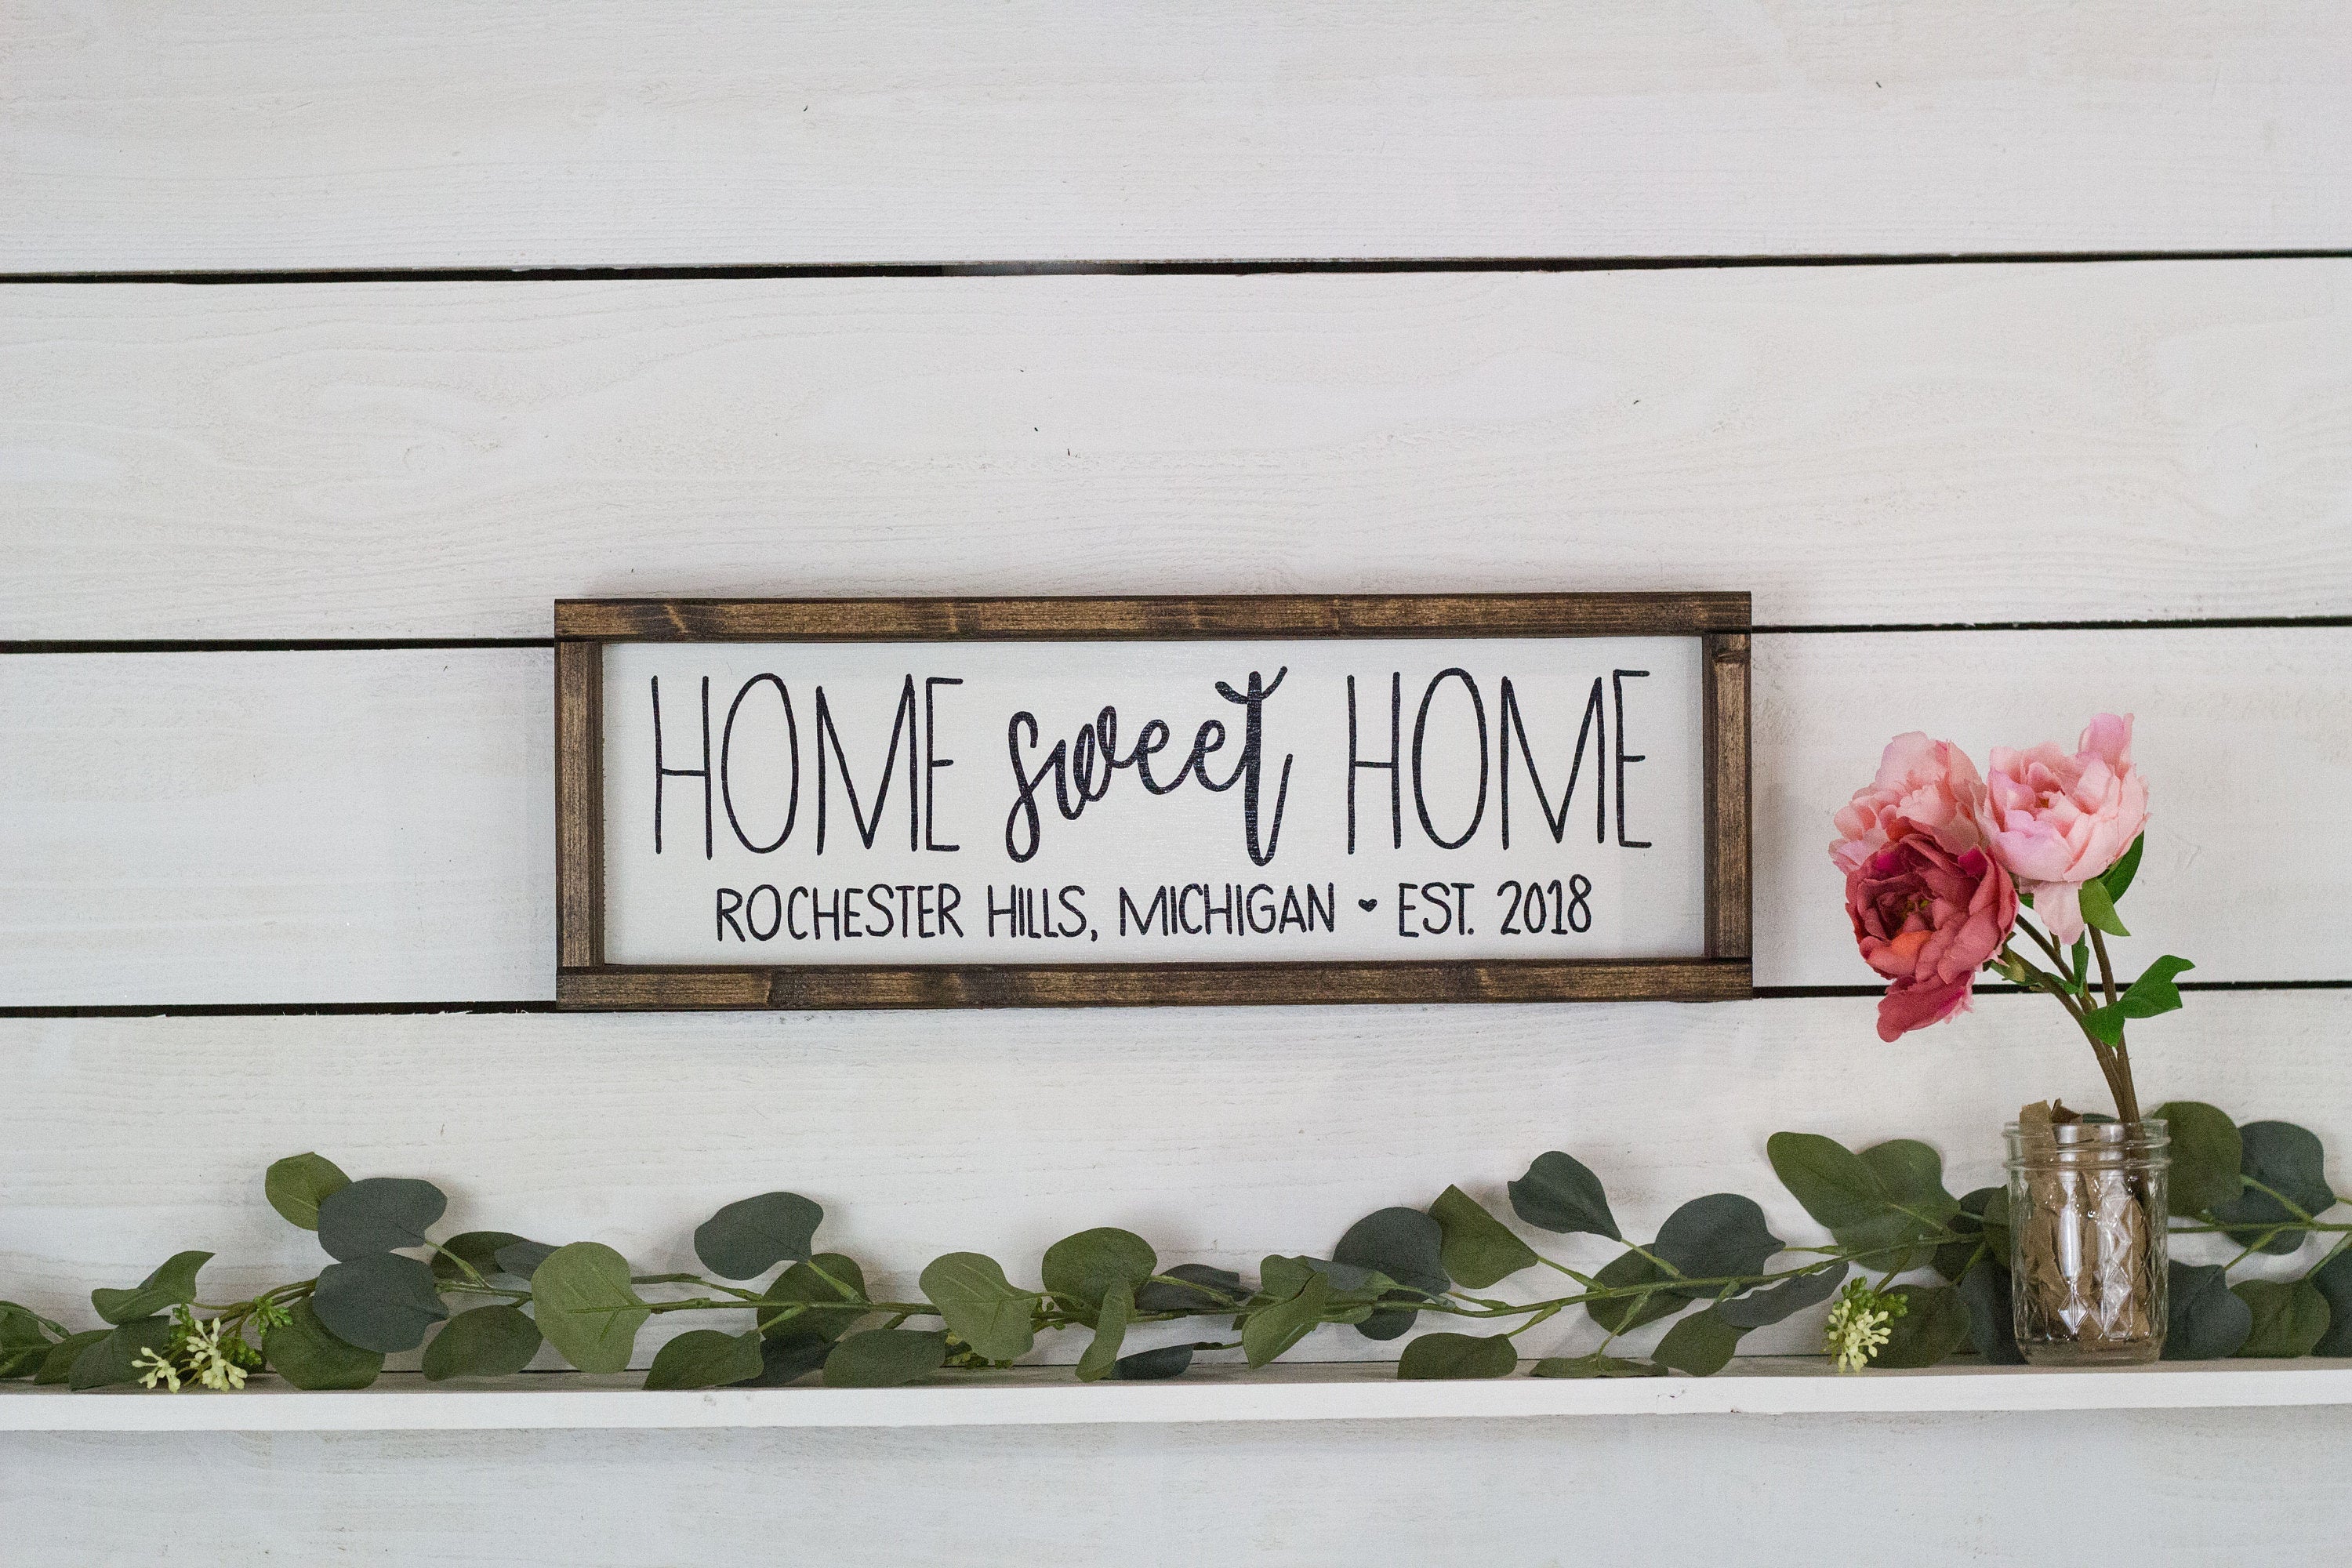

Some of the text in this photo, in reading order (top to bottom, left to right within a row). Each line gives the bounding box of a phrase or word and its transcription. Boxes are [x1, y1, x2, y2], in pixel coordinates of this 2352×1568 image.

[651, 666, 1653, 867] HOME sweet HOME
[716, 873, 1592, 942] ROCHESTER HILLS, MICHIGAN EST. 2018
